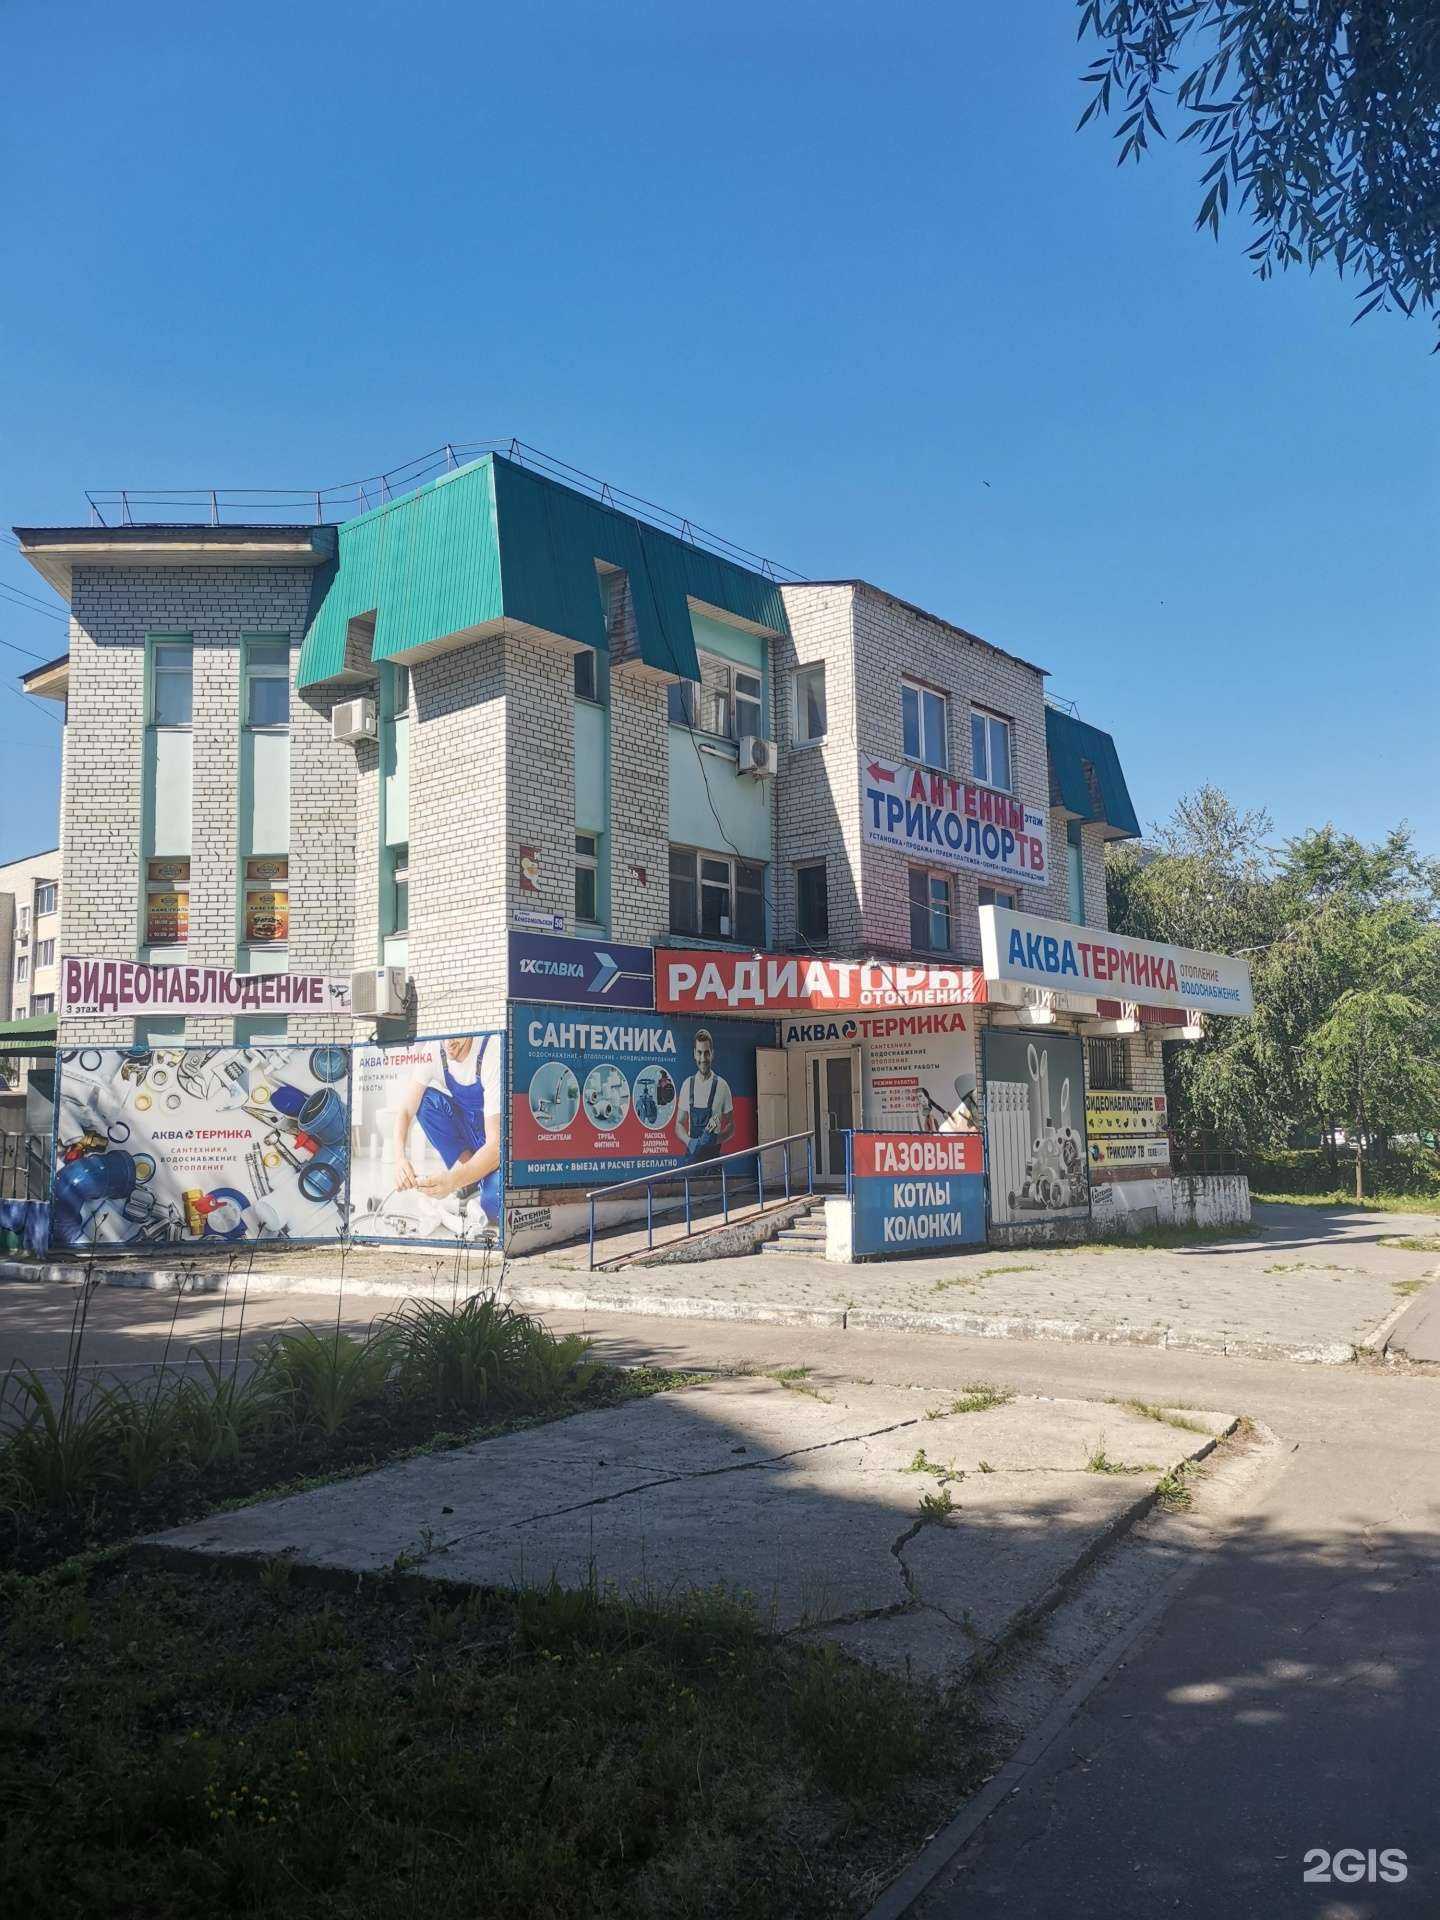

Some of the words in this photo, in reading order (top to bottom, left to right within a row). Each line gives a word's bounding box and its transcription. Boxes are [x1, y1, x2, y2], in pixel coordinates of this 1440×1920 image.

[911, 770, 1025, 832] АНТЕННЫ
[1024, 814, 1043, 826] этаж
[1180, 964, 1219, 982] ОТОПЛЕНИЕ
[66, 960, 323, 1012] ВИДЕОНАБЛЮДЕНИЕ
[668, 960, 974, 1006] РАДИАТОРЫ
[1181, 981, 1241, 1001] ВОДОСНАБЖЕНИЕ
[861, 988, 975, 1005] ОТОПЛЕНИЯ
[75, 1005, 98, 1014] этаж
[786, 1022, 840, 1043] АКВА
[859, 1012, 967, 1038] ТЕРМИКА
[528, 1021, 676, 1054] САНТЕХНИКА
[360, 1056, 382, 1067] АКВА
[390, 1053, 433, 1065] ТЕРМИКА
[870, 1049, 926, 1057] ВОДОСНАБЖЕНИЕ
[1086, 1096, 1153, 1114] ВИДЕОНАБЛЮДЕНИЕ
[151, 1131, 183, 1140] АКВА
[195, 1129, 252, 1139] ТЕРМИКА
[160, 1155, 237, 1163] ВОДОСНАБЖЕНИЕ
[874, 1142, 966, 1172] ГАЗОВЫЕ
[1106, 1145, 1137, 1159] ТРИКОЛОР
[1138, 1145, 1145, 1157] ТВ
[528, 1163, 563, 1173] МОНТАЖ
[571, 1162, 598, 1171] ВЫЕЗД
[601, 1161, 606, 1170] И
[607, 1160, 635, 1169] РАСЧЕТ
[637, 1159, 678, 1168] БЕСПЛАТНО
[893, 1182, 950, 1209] КОТЛЫ
[513, 1208, 551, 1224] АНТЕННЫ
[884, 1212, 962, 1242] КОЛОНКИ
